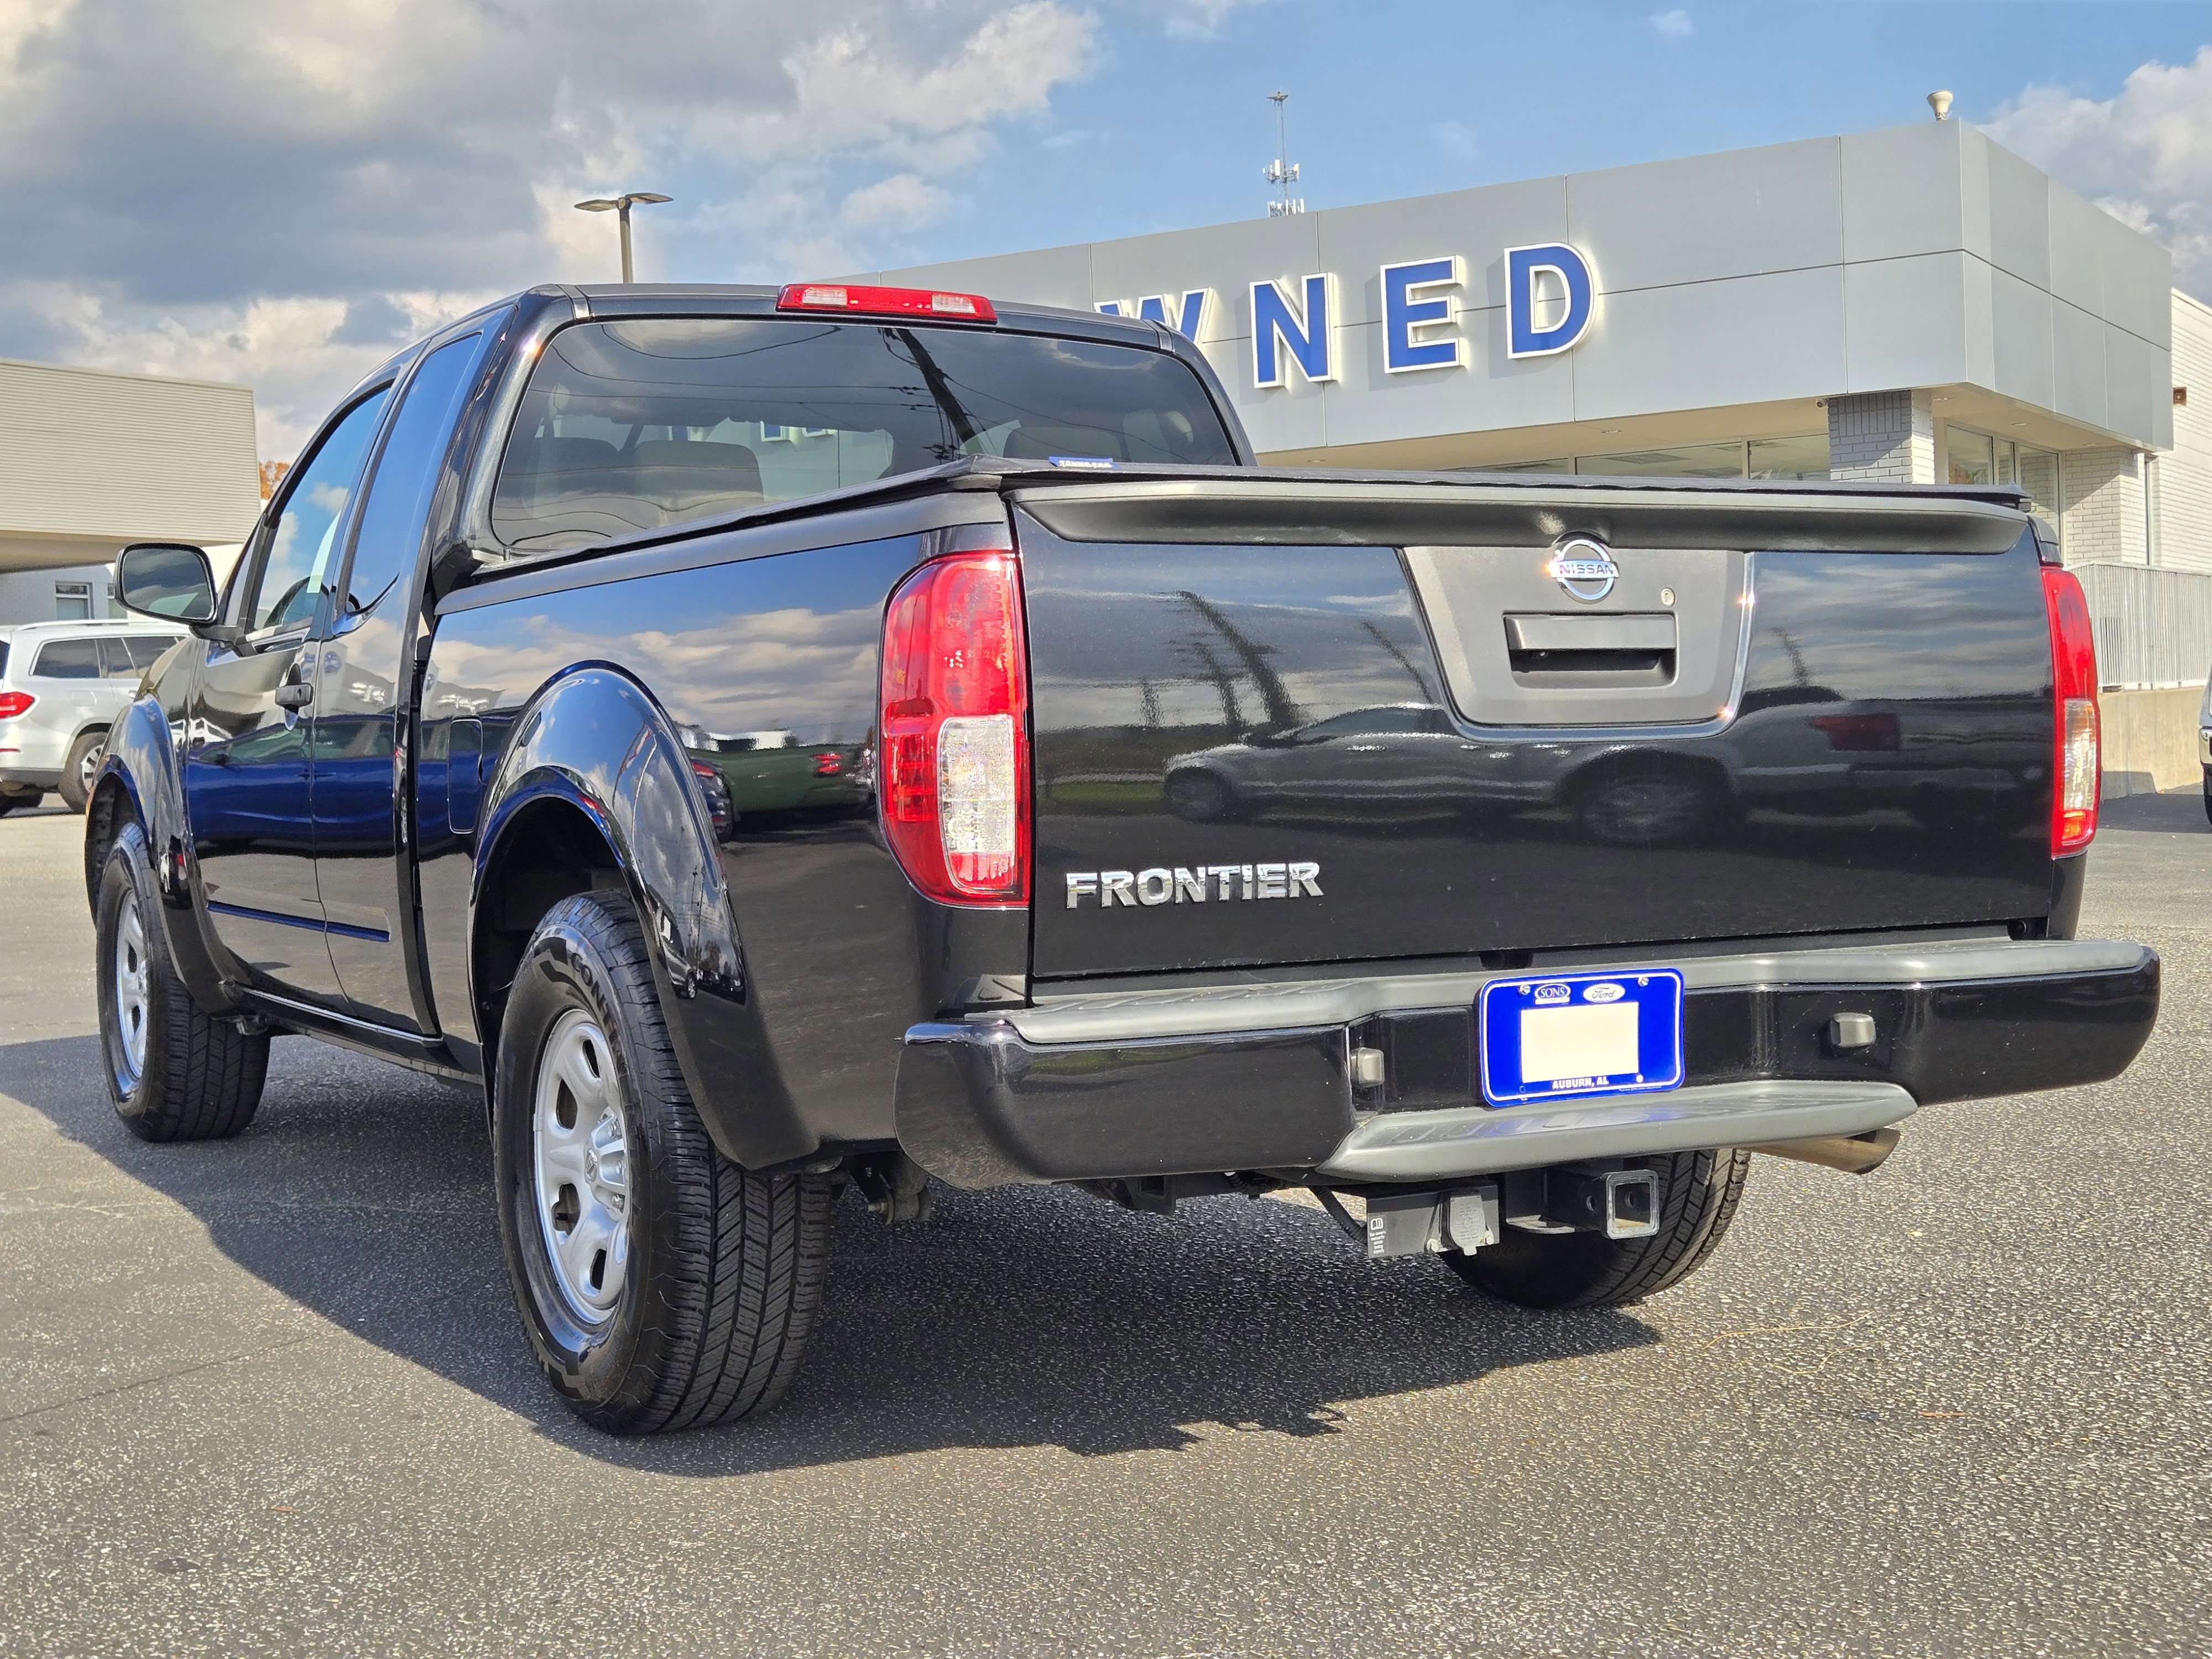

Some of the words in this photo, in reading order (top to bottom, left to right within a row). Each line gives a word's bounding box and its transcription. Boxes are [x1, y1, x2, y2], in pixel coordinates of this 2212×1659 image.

[1559, 564, 1614, 575] NISSAN
[1066, 862, 1324, 909] FRONTIER
[1540, 987, 1565, 998] SONS
[1592, 987, 1616, 999] Ford
[1552, 1078, 1595, 1089] AUBURN,
[1596, 1076, 1609, 1085] AL
